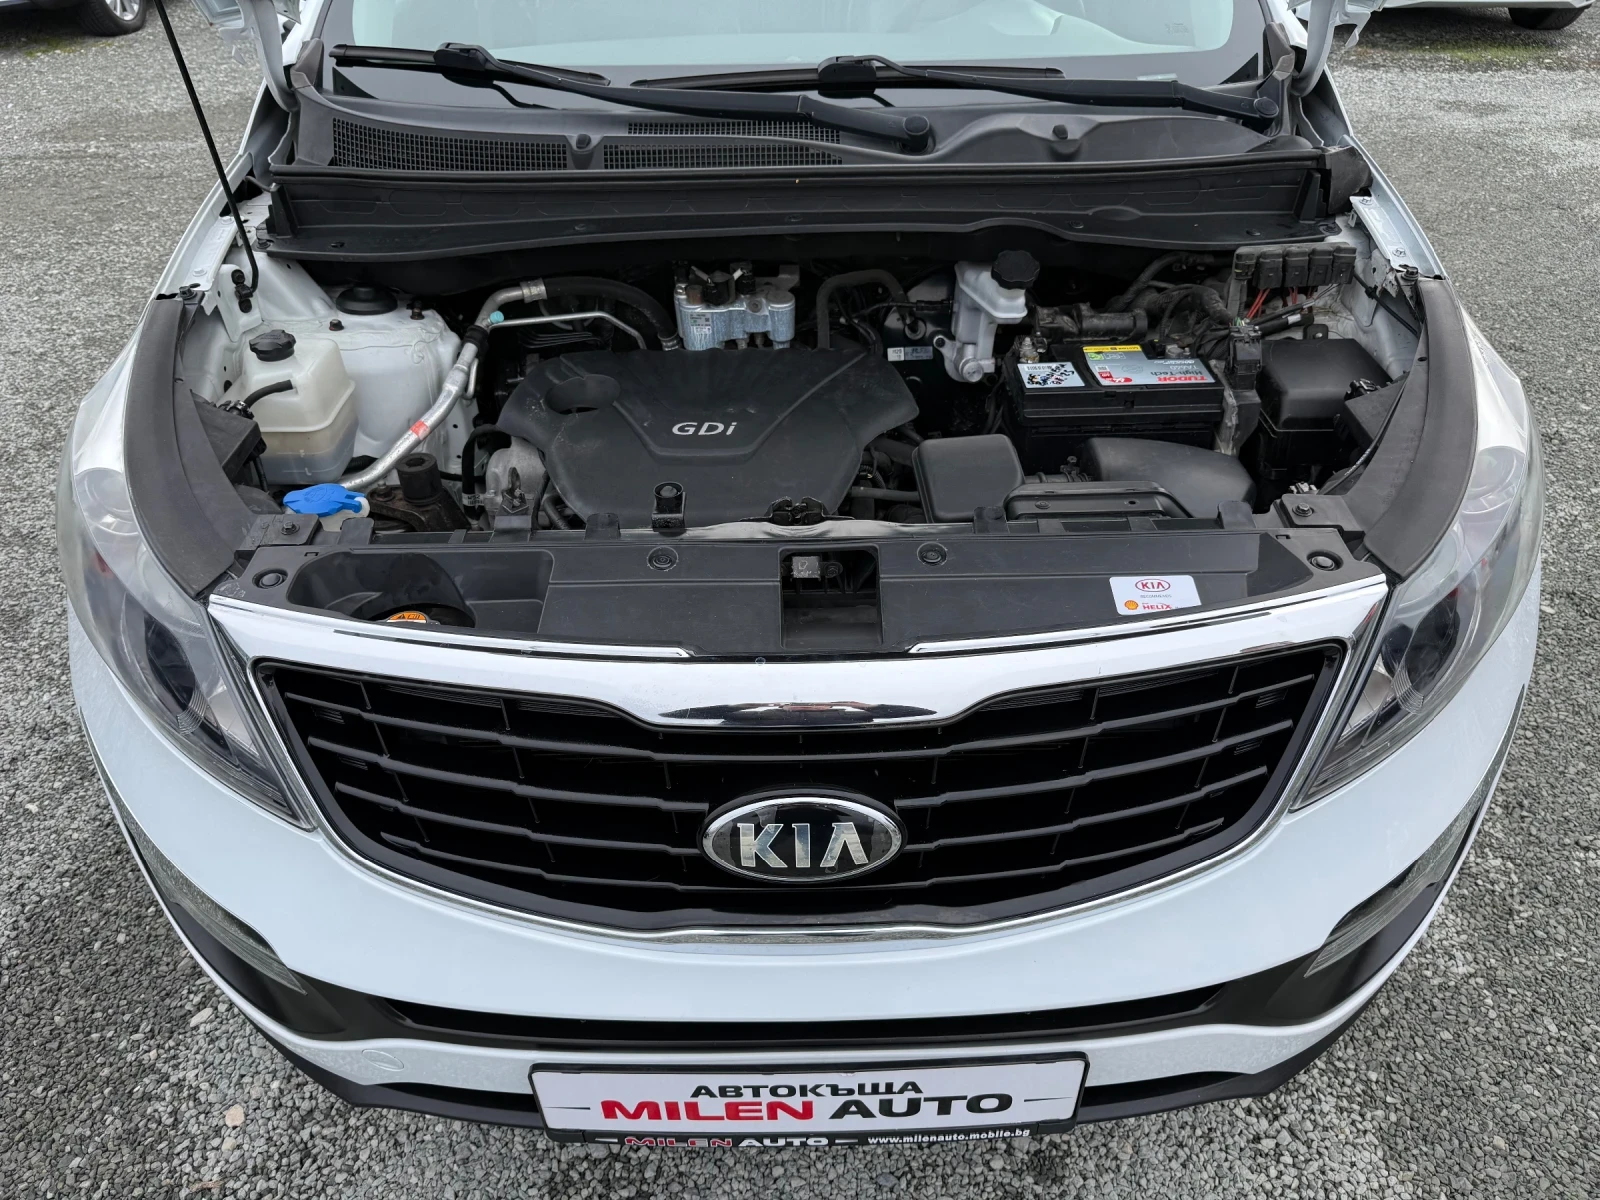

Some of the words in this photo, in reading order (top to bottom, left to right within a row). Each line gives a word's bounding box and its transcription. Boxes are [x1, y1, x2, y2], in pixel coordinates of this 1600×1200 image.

[672, 422, 737, 436] GDi
[1141, 581, 1165, 590] KIA
[737, 822, 869, 868] KIA
[600, 1099, 814, 1121] MILEN
[829, 1093, 1013, 1120] AUTO
[624, 1136, 733, 1147] MILEN
[738, 1136, 829, 1147] AUTO
[867, 1128, 1031, 1145] www.milenauto.mobile.bg
